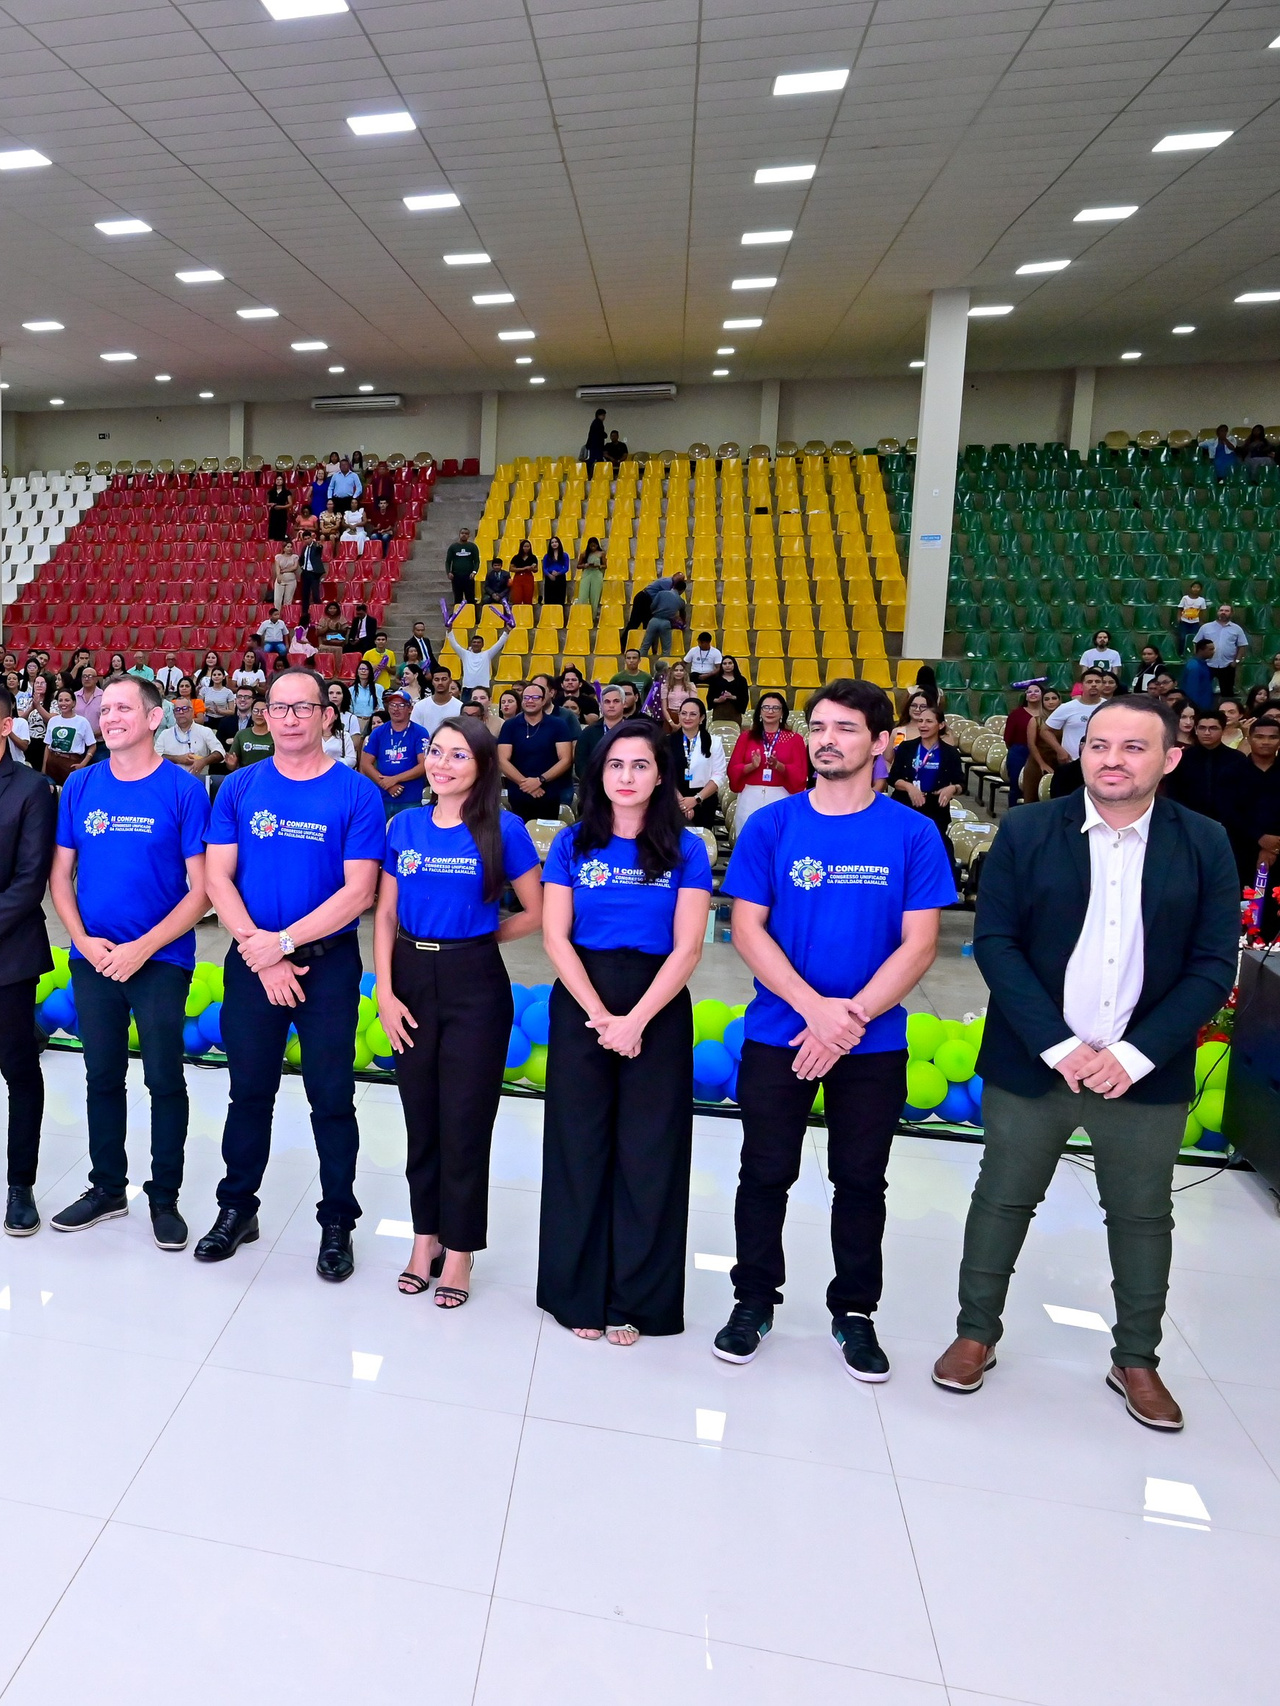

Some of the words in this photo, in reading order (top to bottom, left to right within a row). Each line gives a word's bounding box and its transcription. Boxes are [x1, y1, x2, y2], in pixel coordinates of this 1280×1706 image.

[286, 820, 328, 831] CONFATEFIG
[431, 857, 477, 865] CONFATEFIG
[835, 865, 889, 874] CONFATEFIG
